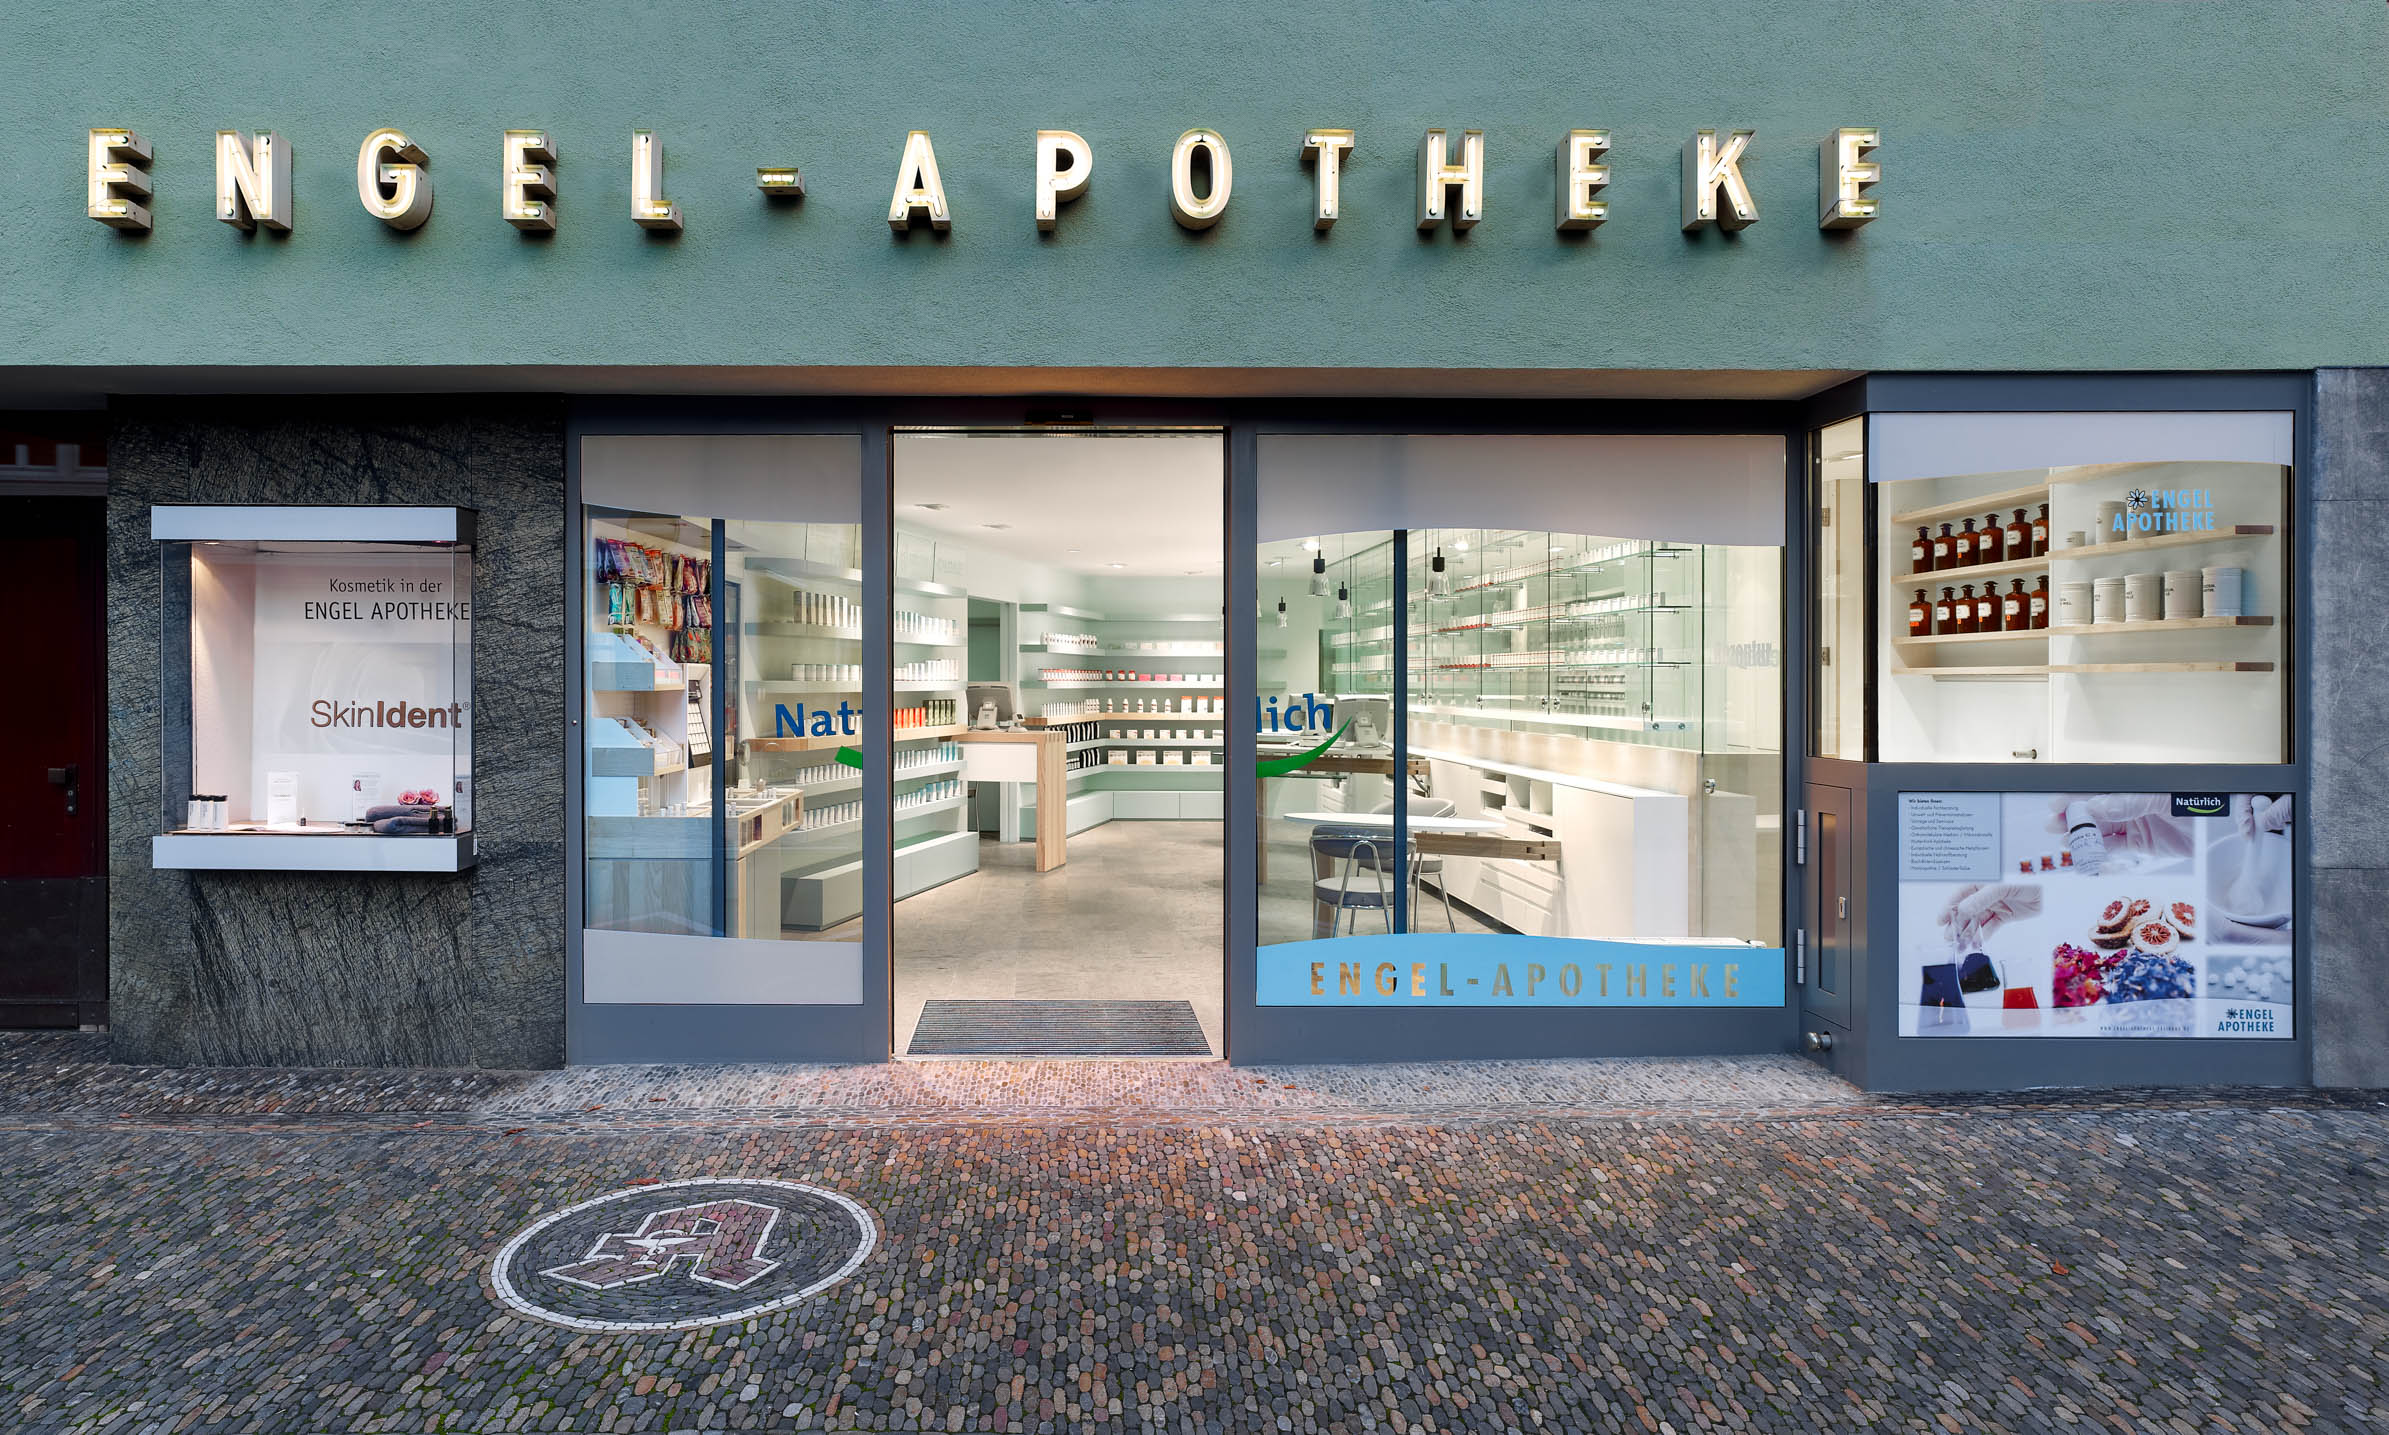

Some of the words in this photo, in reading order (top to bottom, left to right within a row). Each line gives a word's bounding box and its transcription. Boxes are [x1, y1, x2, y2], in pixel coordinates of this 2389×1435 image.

[2151, 490, 2213, 509] ENGEL
[2112, 511, 2215, 532] APOTHEKE
[329, 578, 395, 593] Kosmetik
[400, 579, 414, 593] in
[419, 578, 443, 593] der
[304, 601, 363, 620] ENGEL
[371, 602, 470, 620] APOTHEKE
[775, 700, 863, 738] Nat
[2176, 797, 2221, 806] Natürlich
[1311, 962, 1740, 998] ENGEL-APOTHEKE
[2239, 1009, 2274, 1020] ENGEL
[2217, 1021, 2275, 1032] APOTHEKE
